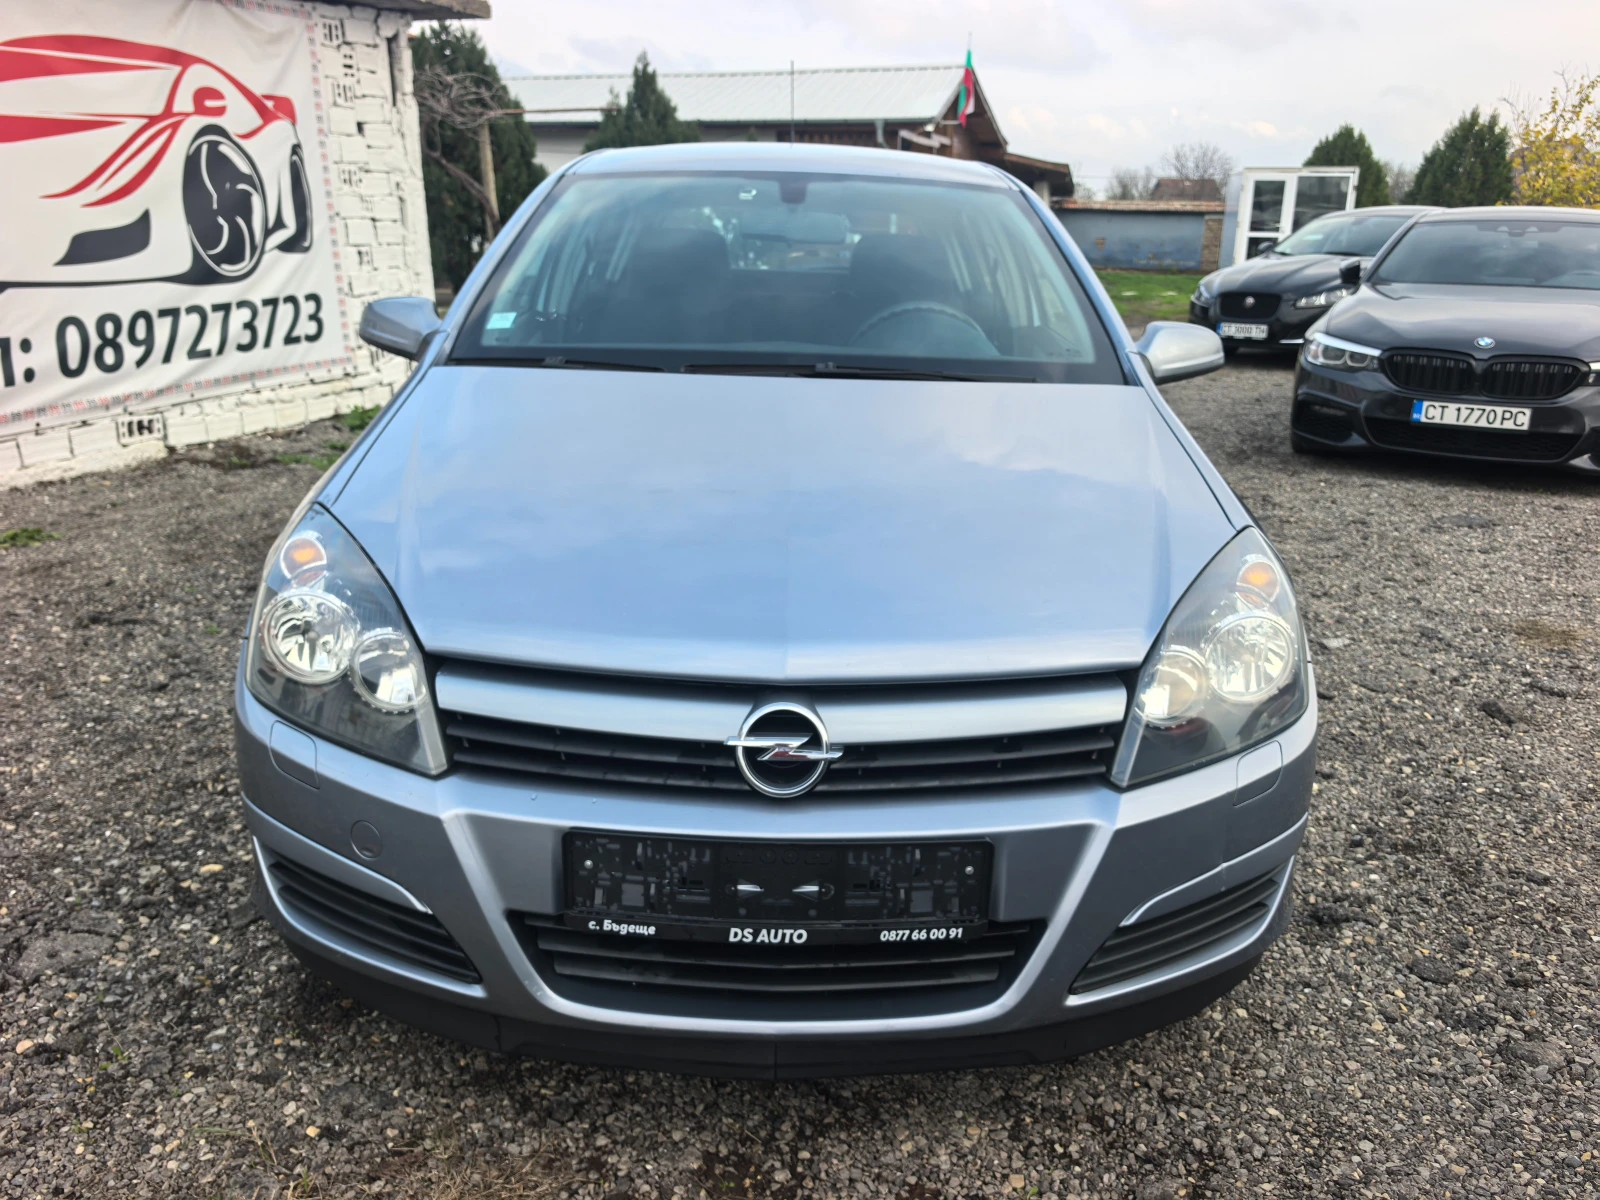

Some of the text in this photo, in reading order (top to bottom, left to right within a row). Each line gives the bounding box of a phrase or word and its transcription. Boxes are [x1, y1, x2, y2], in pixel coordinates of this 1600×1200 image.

[56, 293, 324, 378] 0897273723
[1424, 404, 1449, 421] CT
[1455, 406, 1497, 425] 1770
[1500, 410, 1526, 427] PC
[603, 919, 656, 935] Бъдеще
[729, 927, 808, 944] DS AUTO
[880, 927, 964, 942] 0877 66 00 91
